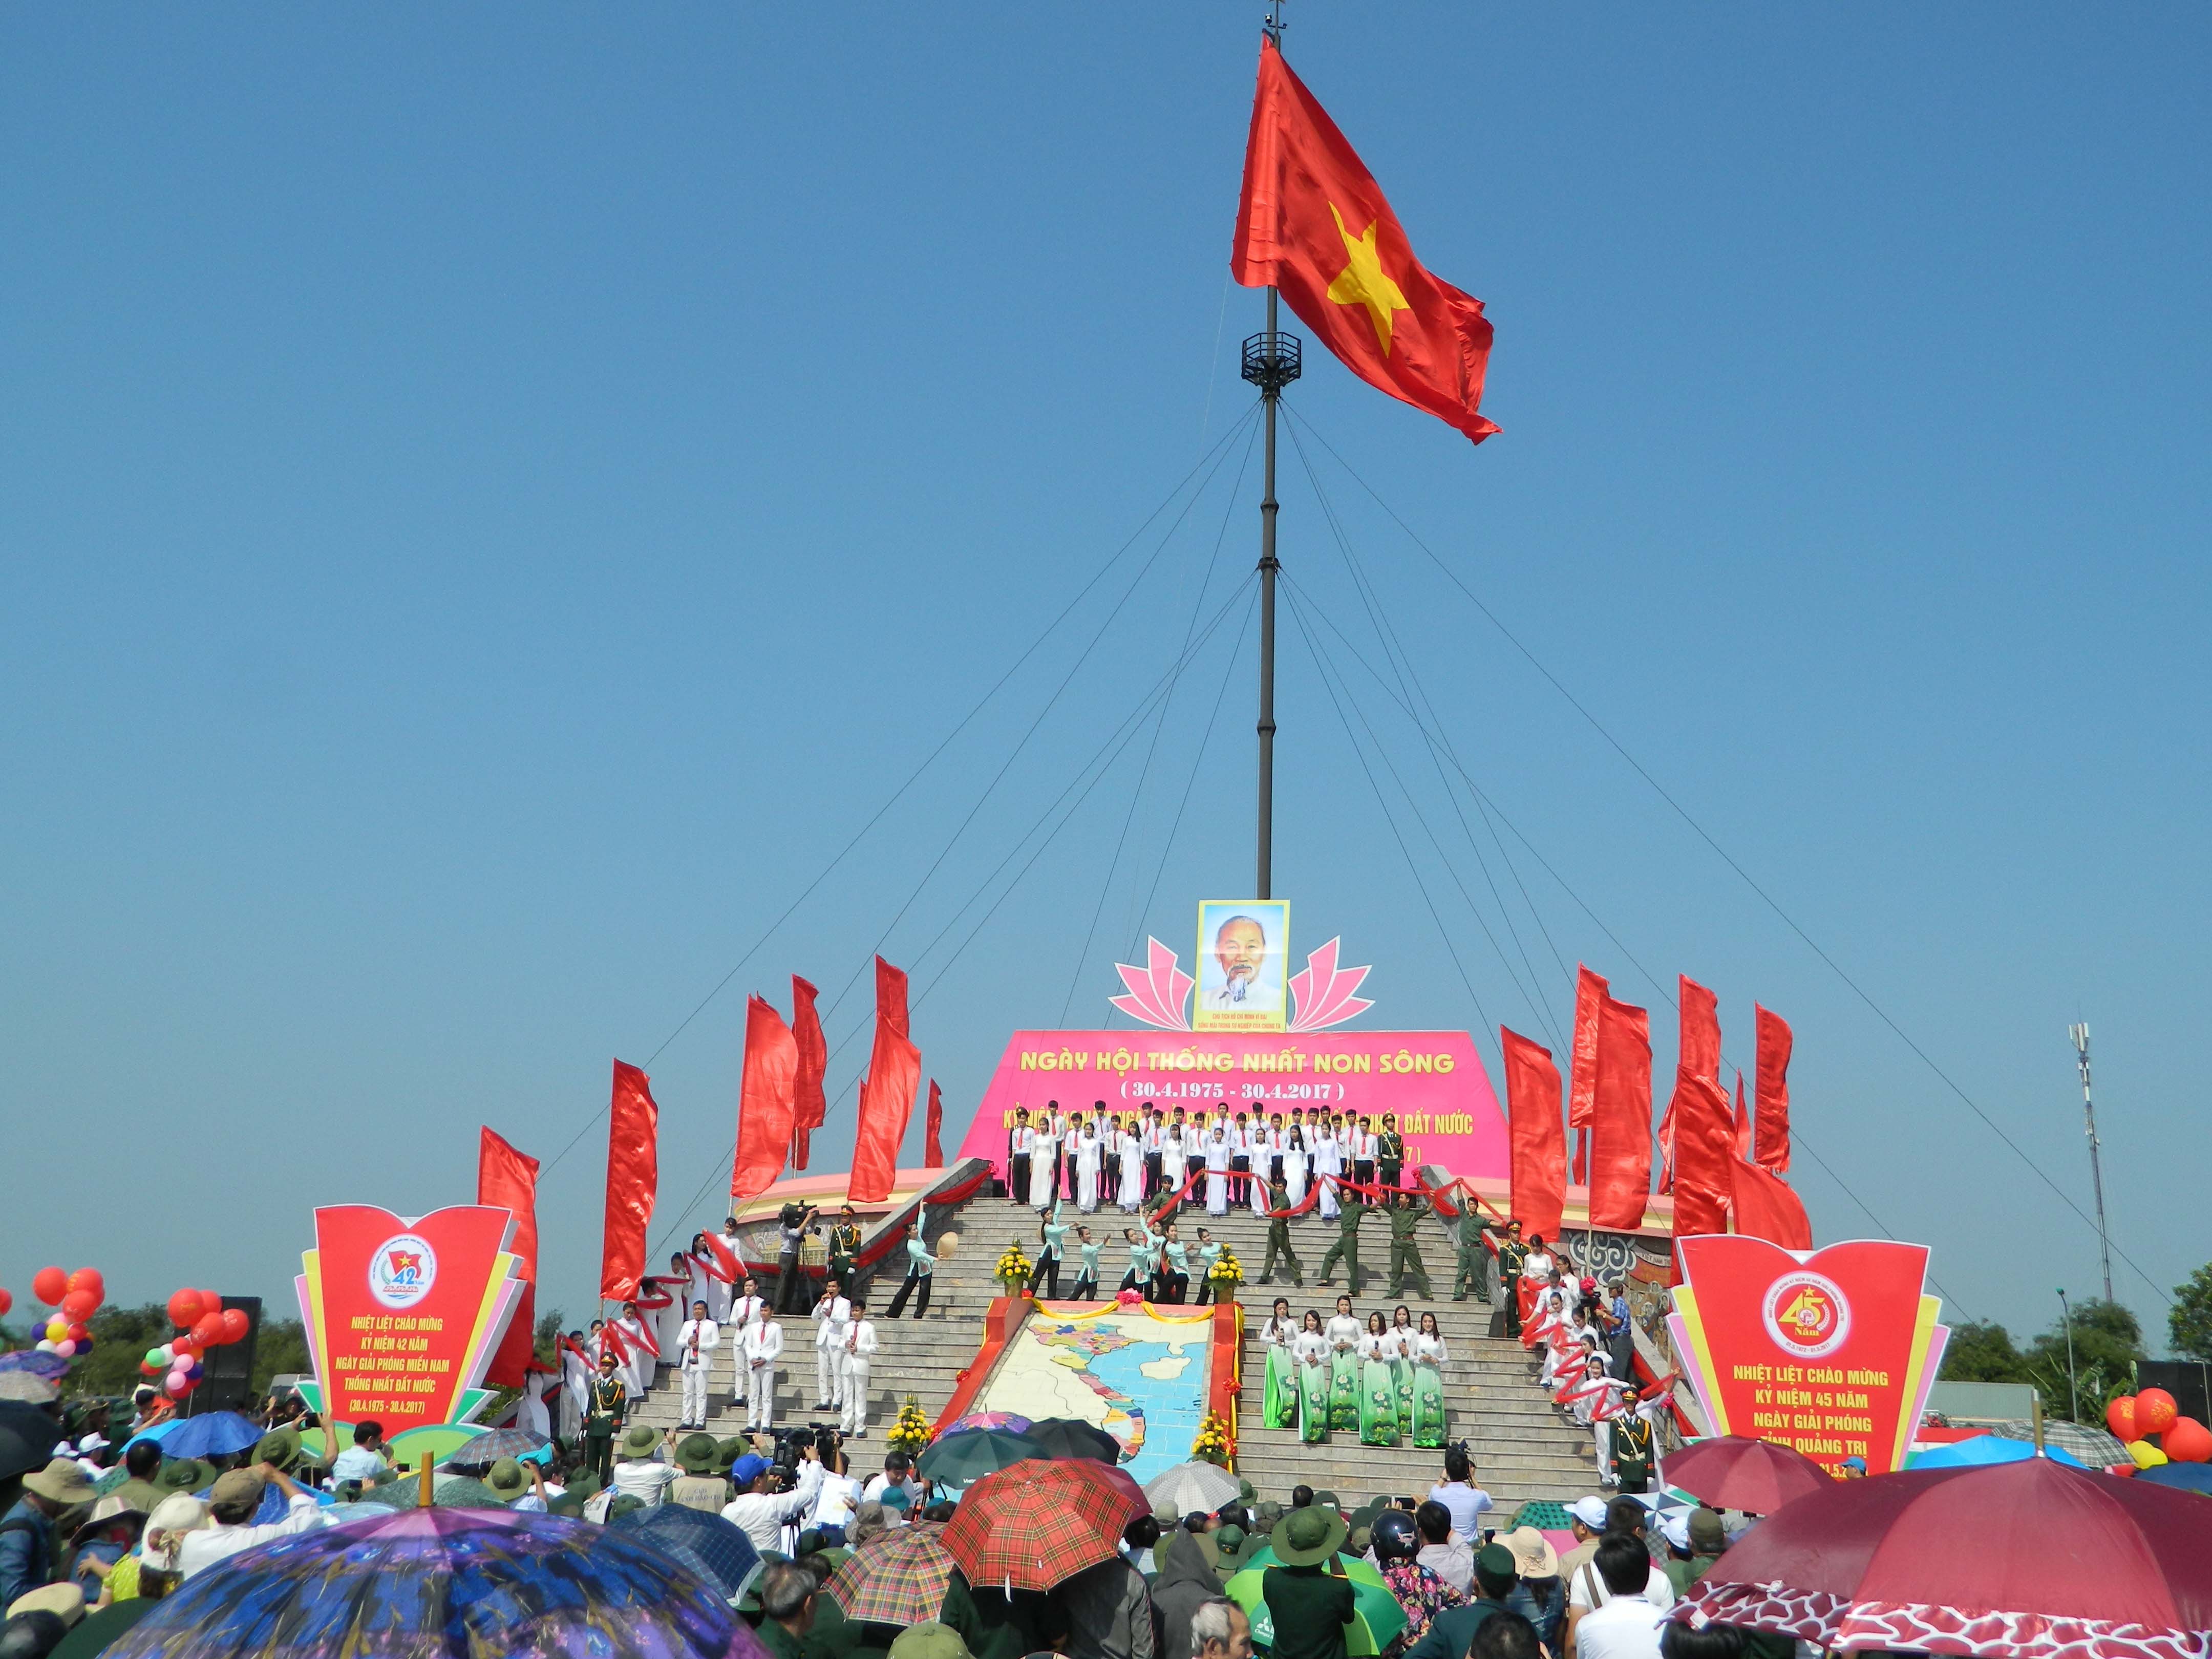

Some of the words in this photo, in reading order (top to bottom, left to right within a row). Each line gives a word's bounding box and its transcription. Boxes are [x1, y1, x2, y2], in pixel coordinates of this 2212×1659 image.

[1020, 1047, 1088, 1071] NGÀY
[1096, 1047, 1139, 1077] HỘI
[1147, 1045, 1235, 1072] THỐNG
[1243, 1046, 1307, 1073] NHẤT
[1314, 1053, 1370, 1074] NON
[1379, 1049, 1455, 1074] SÔNG
[1404, 1107, 1430, 1134] ĐẤT
[1435, 1108, 1473, 1134] NƯỚC
[392, 1267, 415, 1284] 42
[351, 1314, 375, 1332] NHIỆT
[376, 1315, 393, 1332] LIỆT
[395, 1315, 416, 1331] CHÀO
[418, 1315, 443, 1331] MỪNG
[1795, 1326, 1819, 1336] Năm
[361, 1332, 372, 1350] KỶ
[373, 1335, 395, 1353] NIỆM
[397, 1338, 407, 1350] 42
[409, 1336, 428, 1351] NĂM
[336, 1354, 357, 1370] NGÀY
[359, 1352, 375, 1370] GIẢI
[377, 1356, 405, 1371] PHÓNG
[430, 1359, 450, 1372] NAM
[345, 1374, 371, 1391] THỐNG
[372, 1374, 394, 1392] NHẤT
[396, 1375, 411, 1392] ĐẤT
[413, 1376, 436, 1392] NƯỚC
[1733, 1363, 1772, 1384] NHIỆT
[1776, 1365, 1803, 1385] LIỆT
[1807, 1366, 1843, 1384] CHÀO
[1847, 1367, 1888, 1386] MỪNG
[1755, 1384, 1772, 1404] KỶ
[1777, 1388, 1812, 1409] NIỆM
[1816, 1393, 1832, 1407] 45
[1836, 1390, 1868, 1409] NĂM
[1754, 1410, 1790, 1428] NGÀY
[1794, 1409, 1821, 1430] GIẢI
[1825, 1413, 1872, 1432] PHÓNG
[1795, 1432, 1842, 1455] QUẢNG
[1845, 1439, 1867, 1458] TRỊ
